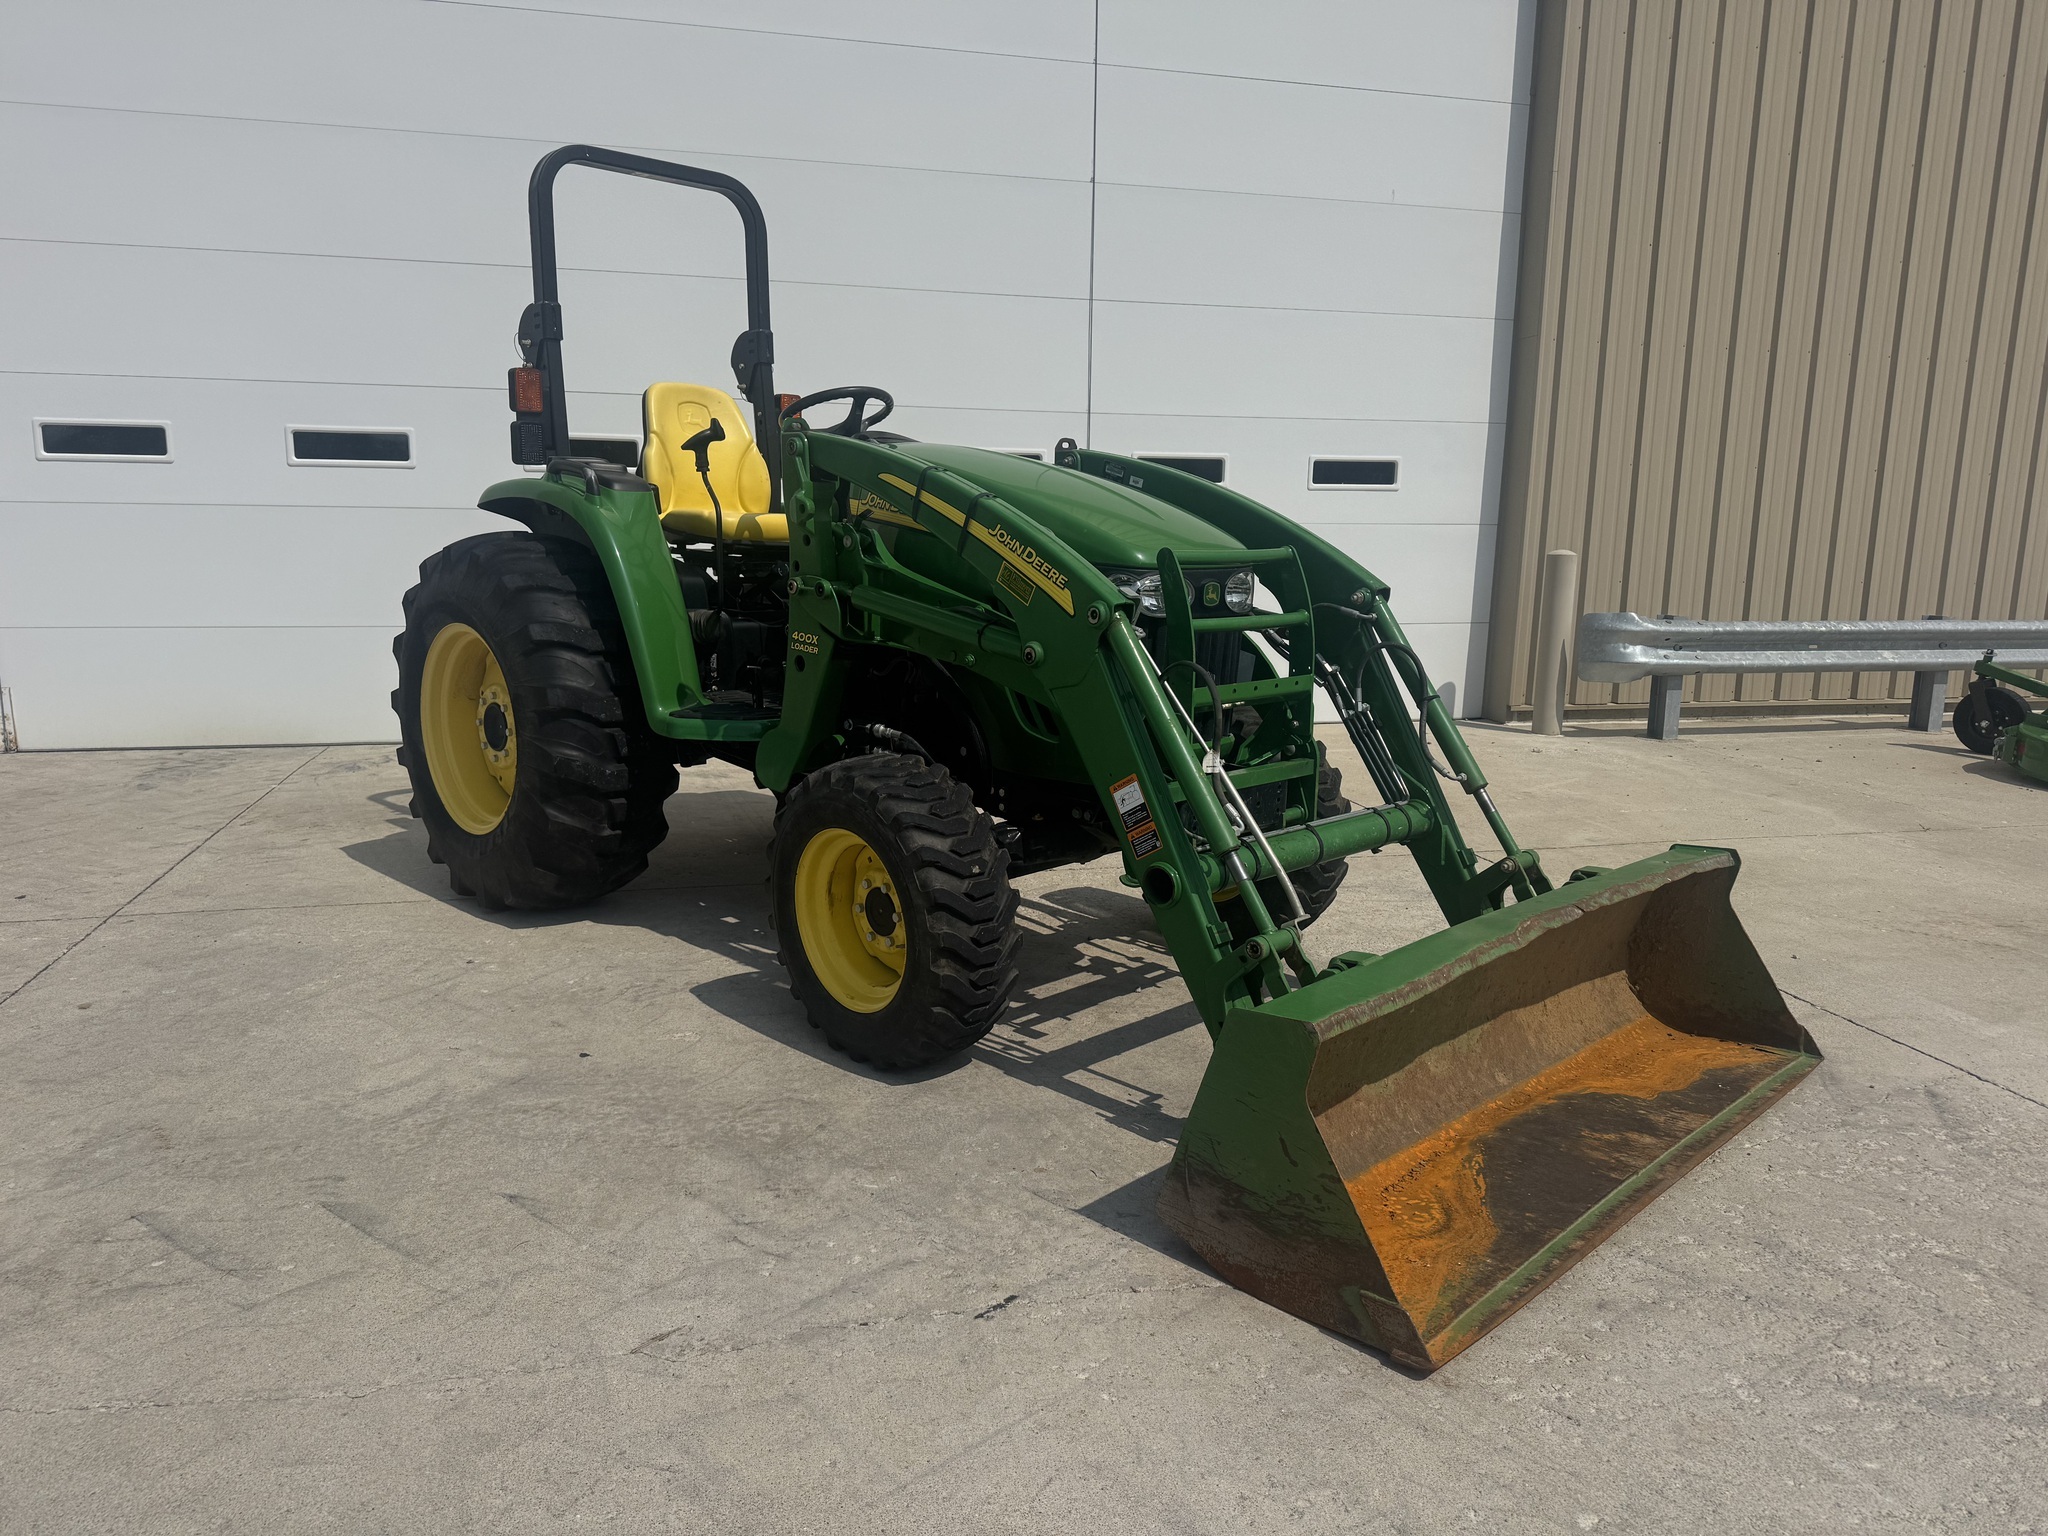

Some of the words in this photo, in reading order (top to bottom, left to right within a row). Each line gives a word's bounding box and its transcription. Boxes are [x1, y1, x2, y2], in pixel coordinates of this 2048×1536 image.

[988, 523, 1025, 556] JOHN
[1022, 546, 1069, 589] DEERE
[791, 631, 819, 645] 400X
[790, 641, 819, 654] LOADER
